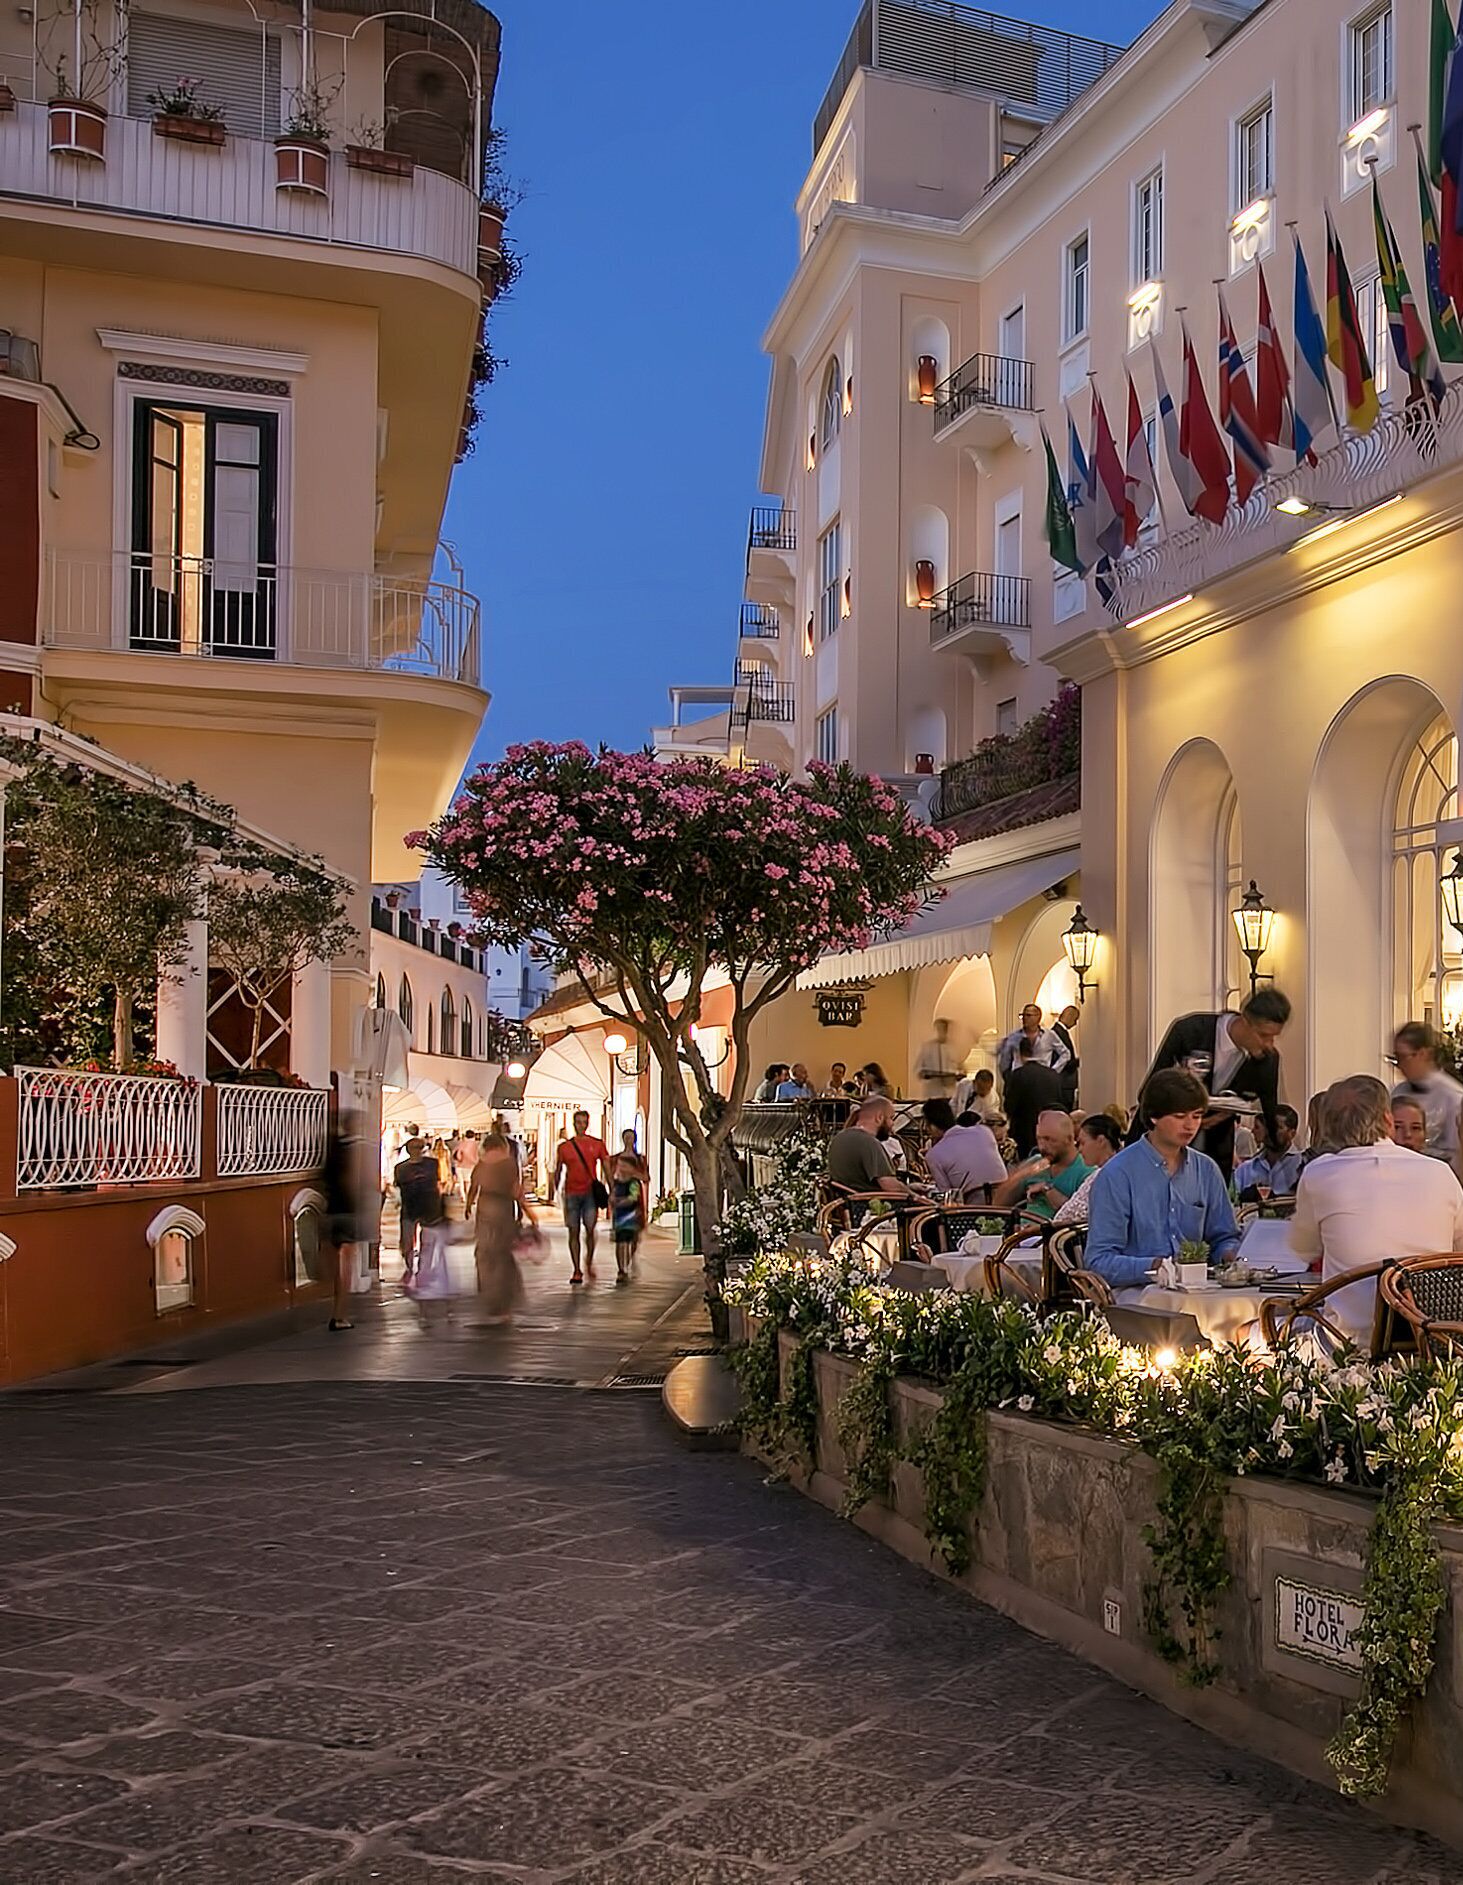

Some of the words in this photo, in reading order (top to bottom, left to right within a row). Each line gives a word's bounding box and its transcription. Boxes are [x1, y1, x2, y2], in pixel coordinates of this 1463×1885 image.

[828, 1011, 853, 1021] BAR
[1295, 1592, 1344, 1626] HOTEL
[1294, 1612, 1356, 1652] FLORA
